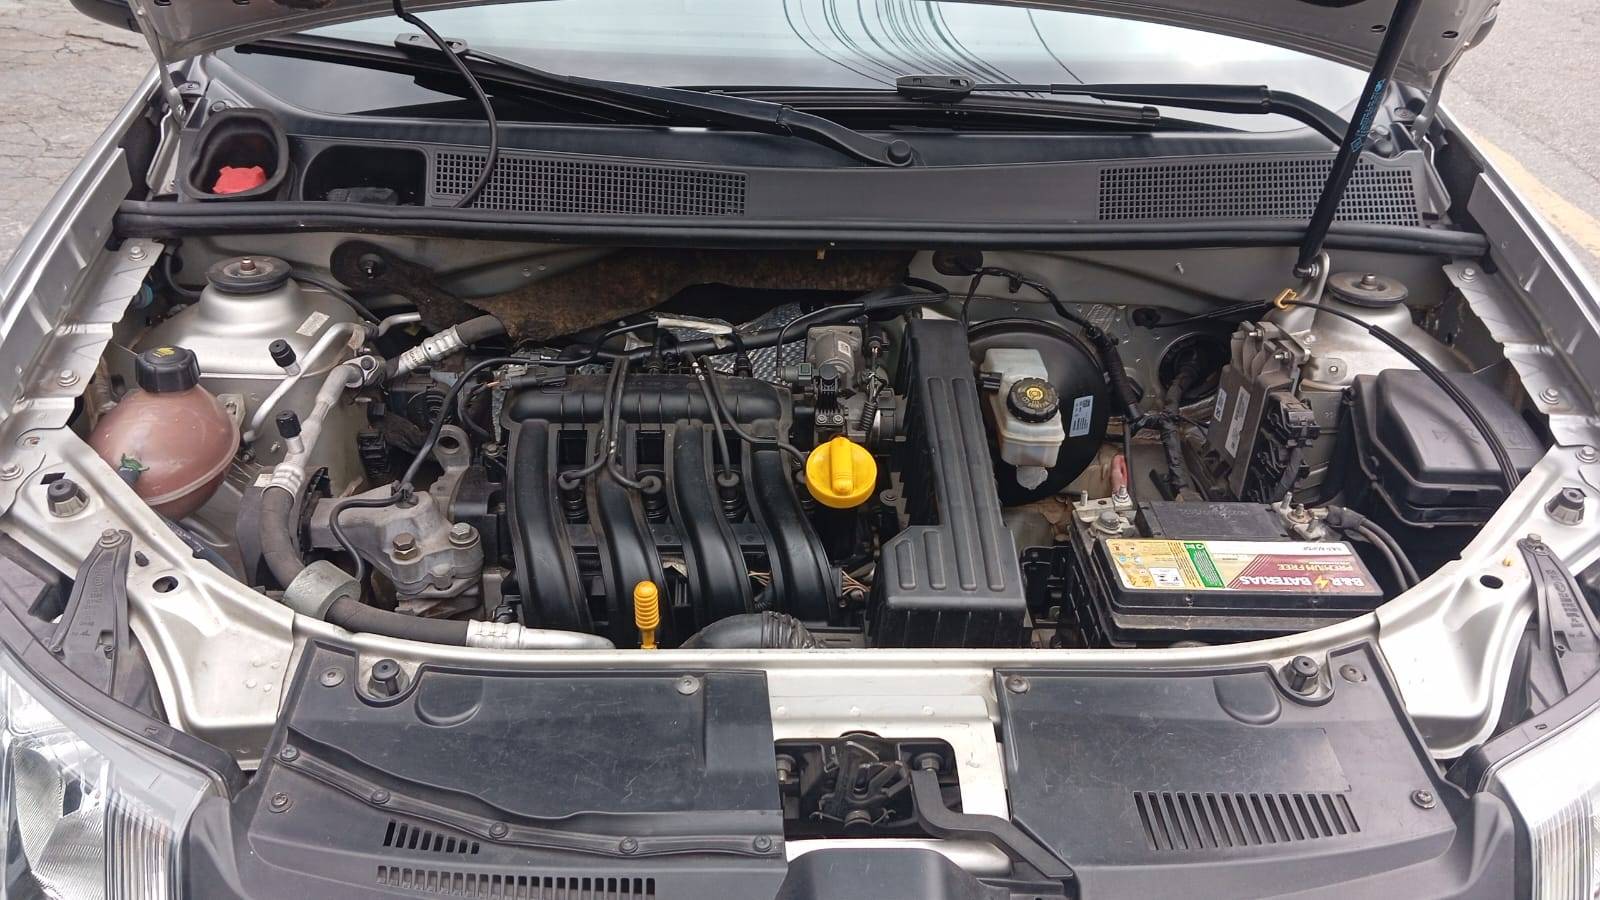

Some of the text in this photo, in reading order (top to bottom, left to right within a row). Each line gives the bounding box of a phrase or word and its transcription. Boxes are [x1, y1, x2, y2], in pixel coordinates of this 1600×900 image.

[1277, 563, 1353, 571] PREMIUM FREE
[1239, 576, 1364, 587] B&R BATERIAS
